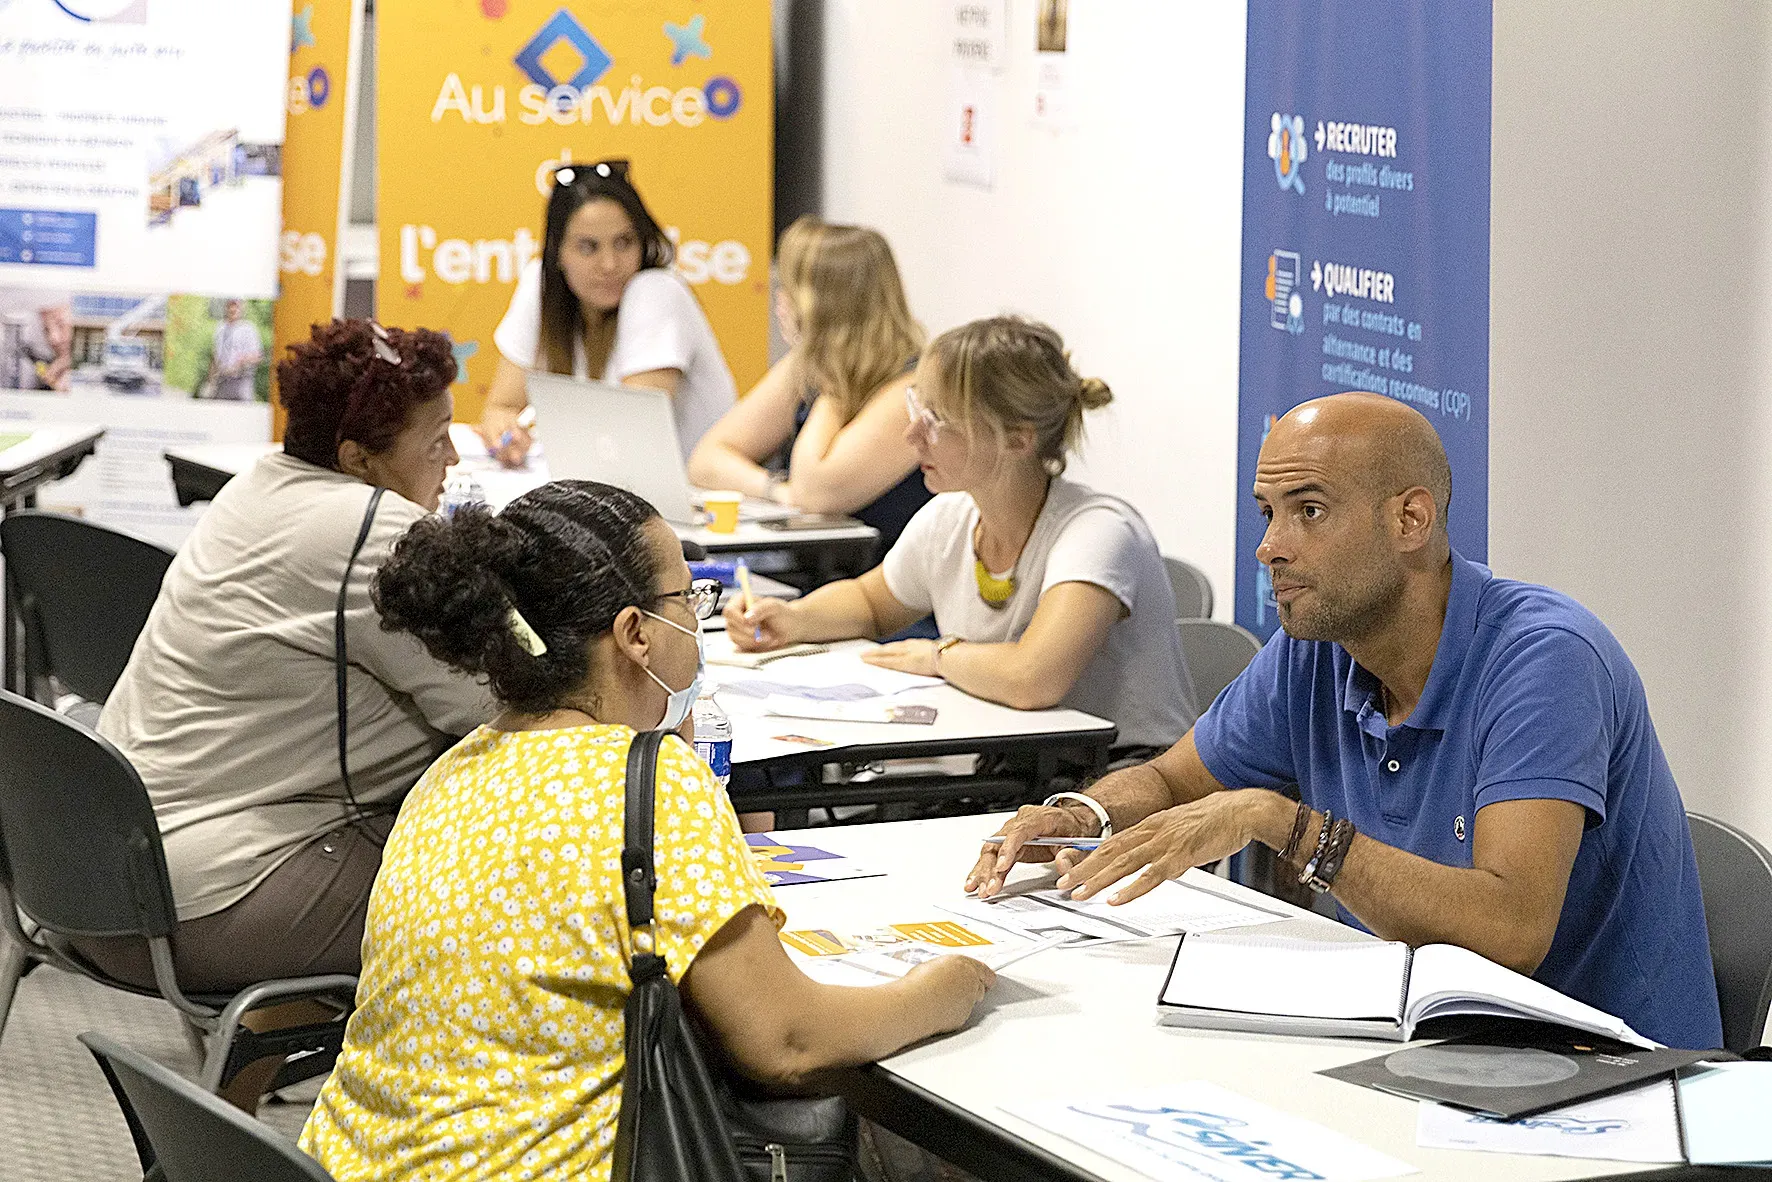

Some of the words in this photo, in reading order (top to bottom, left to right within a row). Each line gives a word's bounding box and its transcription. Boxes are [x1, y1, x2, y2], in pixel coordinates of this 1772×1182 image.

[431, 72, 505, 124] Au
[519, 74, 706, 127] service
[1327, 121, 1397, 158] RECRUTER
[1326, 160, 1345, 182] des
[1345, 162, 1378, 188] profils
[1379, 164, 1414, 192] divers
[1333, 193, 1380, 218] potentiel
[1324, 262, 1395, 303] QUALIFIER
[1323, 303, 1340, 326] par
[1341, 303, 1361, 327] des
[1361, 311, 1405, 337] contrats
[1407, 321, 1422, 341] en
[1322, 333, 1377, 365] alternance
[1378, 347, 1390, 368] et
[1391, 347, 1413, 373] des
[1321, 362, 1388, 394] certifications
[1389, 378, 1440, 410] reconnus
[1441, 388, 1471, 422] (CQP)
